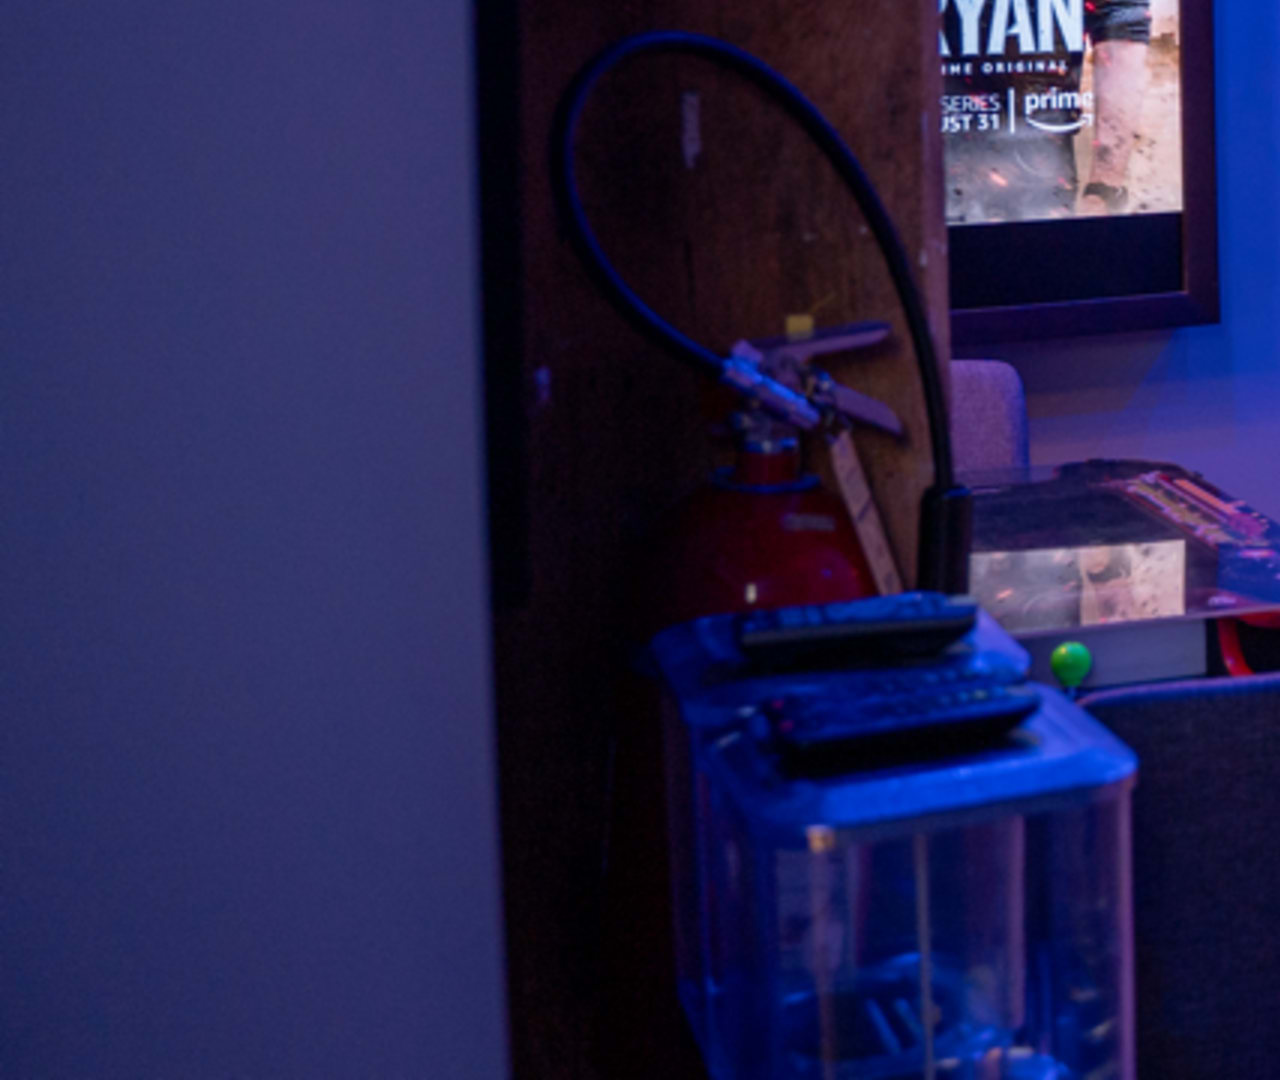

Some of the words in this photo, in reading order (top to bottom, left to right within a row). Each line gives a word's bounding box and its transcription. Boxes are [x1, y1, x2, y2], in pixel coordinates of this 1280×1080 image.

[941, 63, 972, 76] IME
[982, 60, 1068, 74] ORIGINAL
[1025, 86, 1094, 115] prime
[977, 113, 1000, 131] 31
